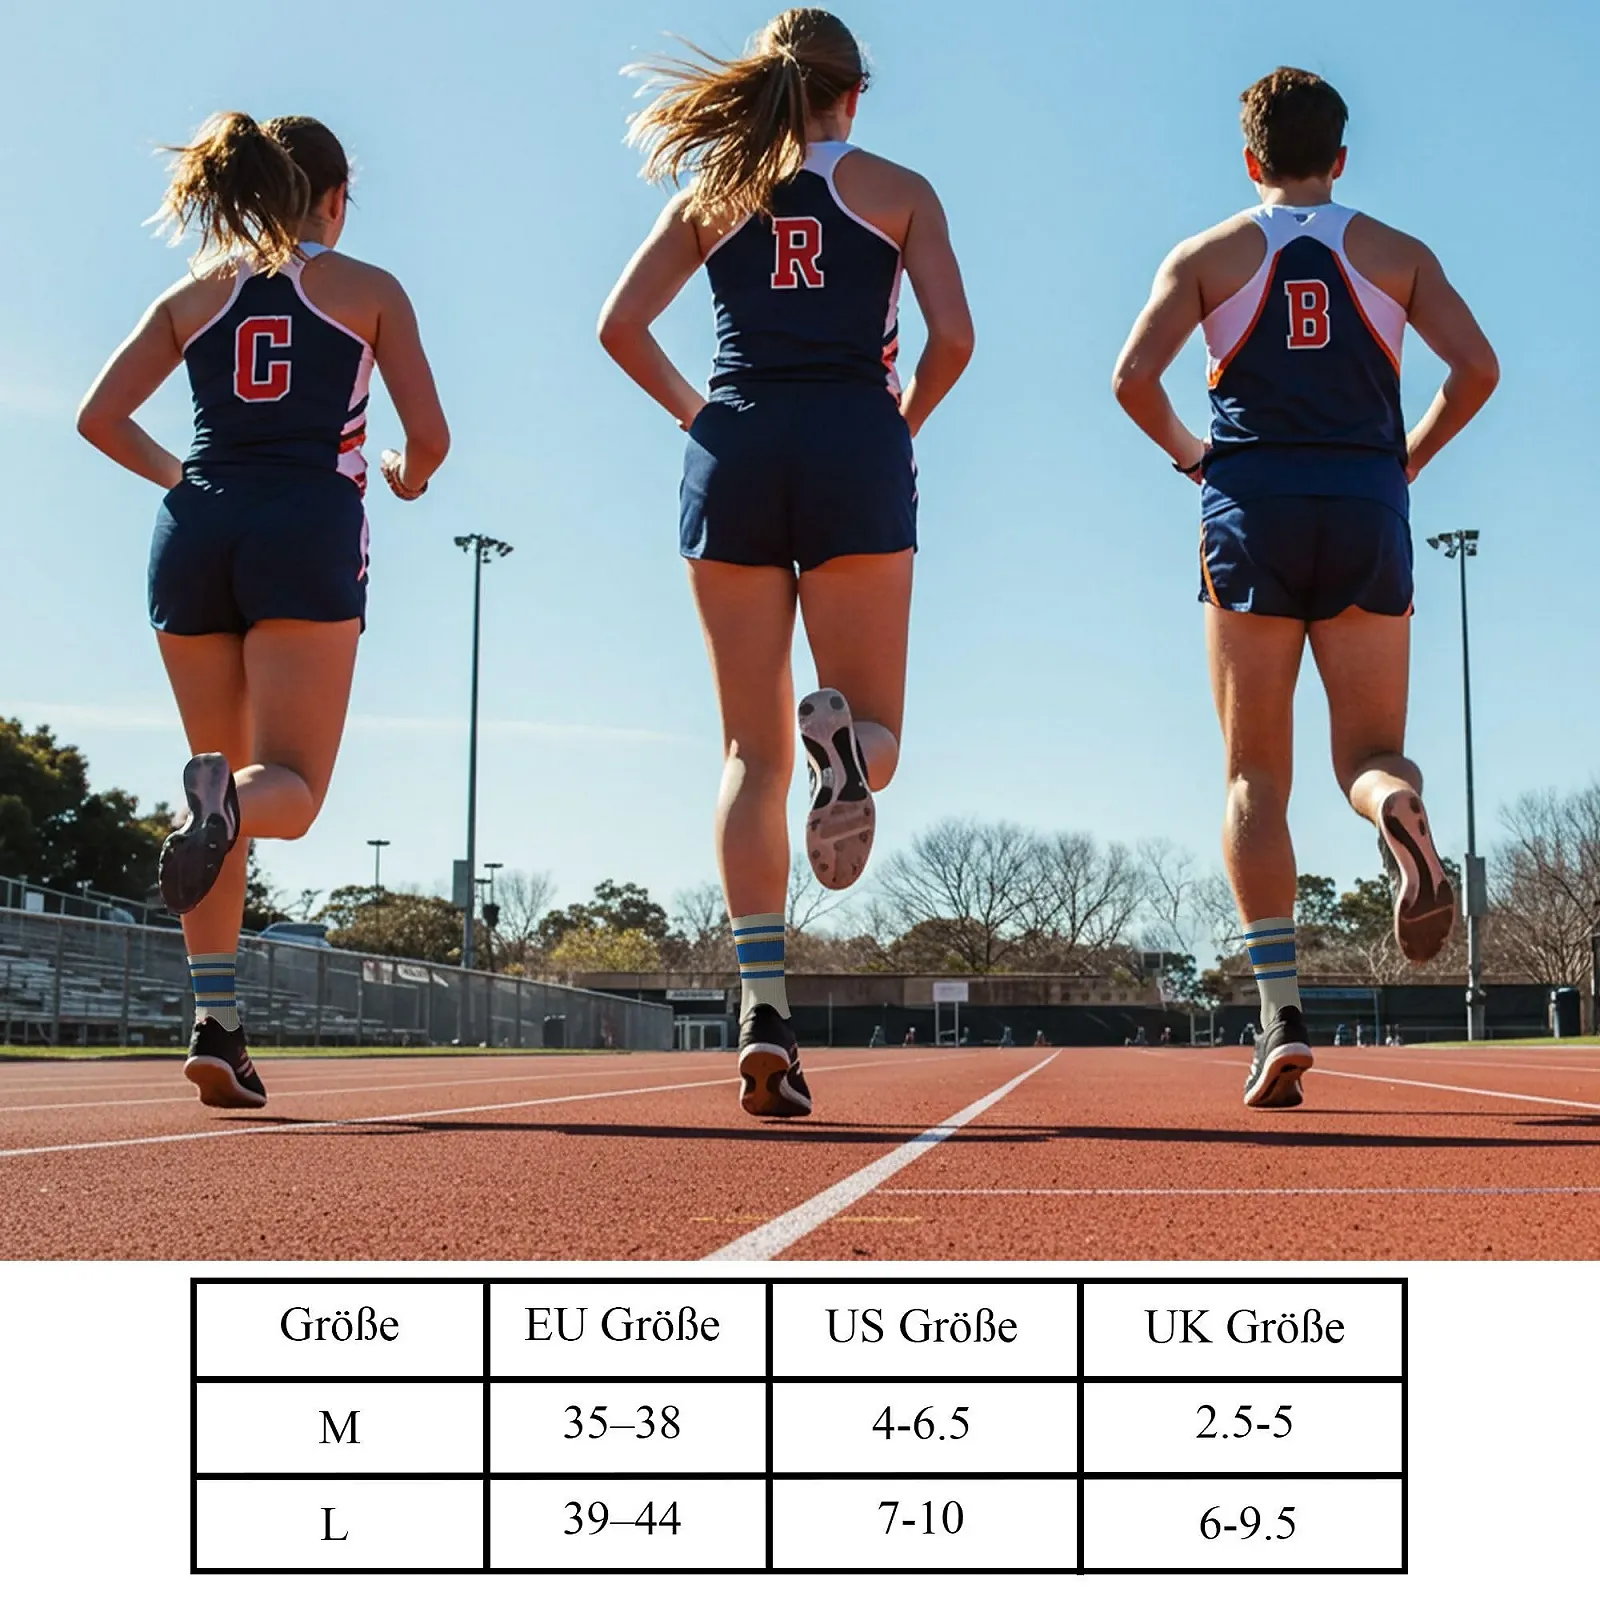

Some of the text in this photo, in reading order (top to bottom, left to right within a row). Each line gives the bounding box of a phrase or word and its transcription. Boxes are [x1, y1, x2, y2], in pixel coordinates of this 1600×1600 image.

[771, 216, 825, 289] R
[1284, 279, 1330, 349] B
[233, 315, 292, 403] C
